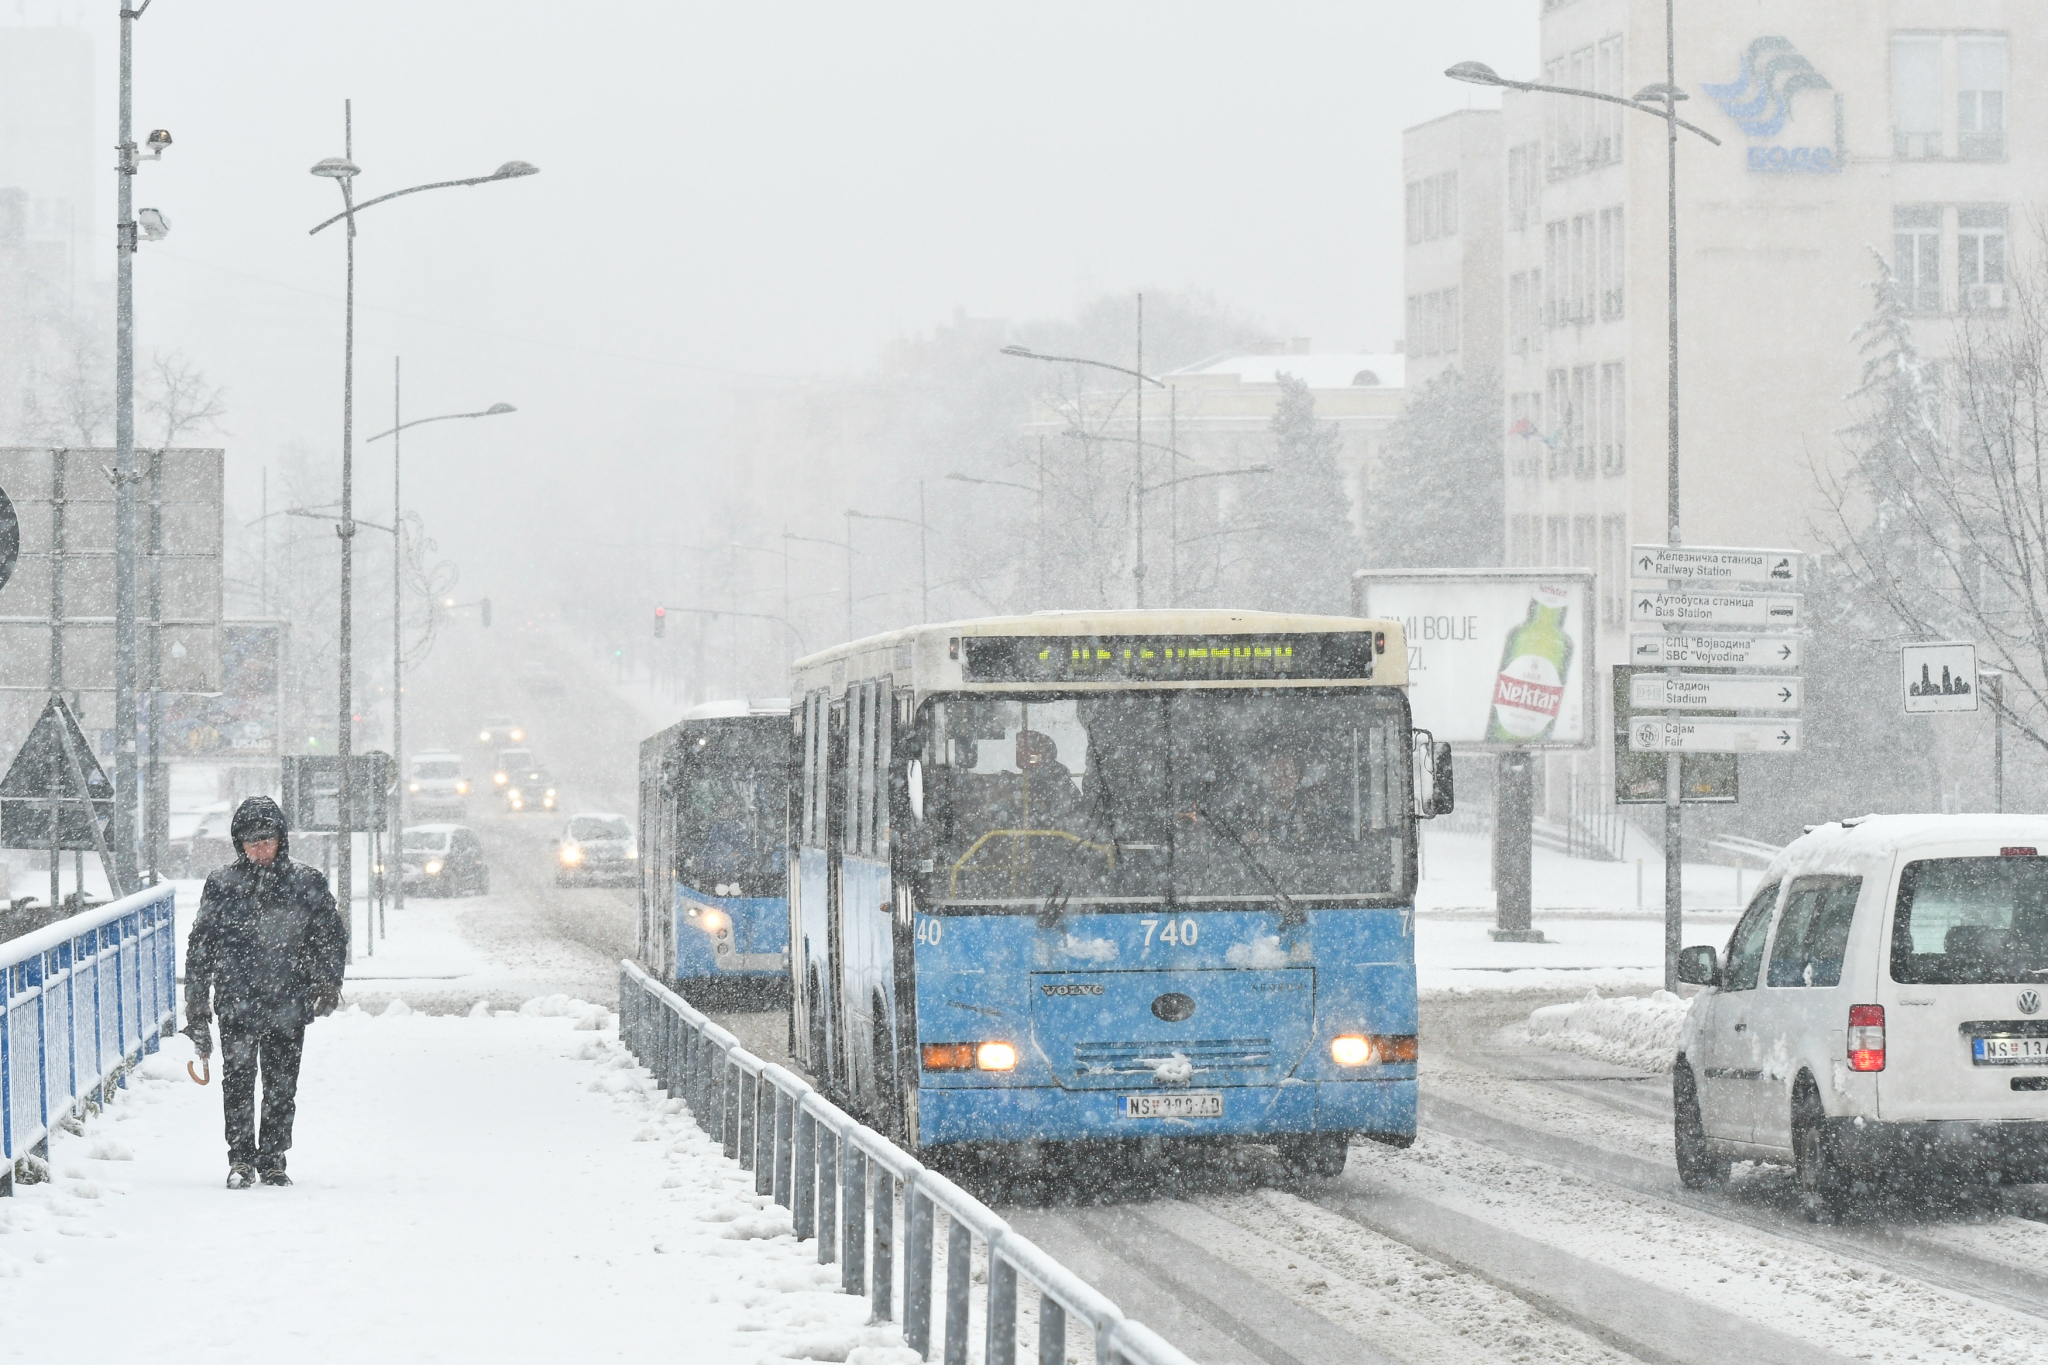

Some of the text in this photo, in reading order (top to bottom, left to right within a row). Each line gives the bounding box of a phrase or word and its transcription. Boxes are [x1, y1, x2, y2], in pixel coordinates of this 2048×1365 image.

[1656, 551, 1763, 565] Железничка станица
[1655, 565, 1732, 577] Railway Station
[1656, 593, 1754, 607] Аутобуска станица
[1655, 607, 1713, 619] Bus Station
[1423, 616, 1478, 641] BOLJE
[1666, 637, 1688, 650] СПЦ
[1665, 650, 1688, 661] SBC
[1666, 680, 1710, 693] Стадион
[1498, 680, 1560, 710] Nektar
[1666, 693, 1707, 704] Stadium
[1665, 723, 1695, 736] Сајам
[1664, 738, 1684, 748] Fair
[1140, 919, 1199, 947] 740
[1041, 984, 1105, 997] VOLVO
[2023, 1040, 2048, 1056] 13
